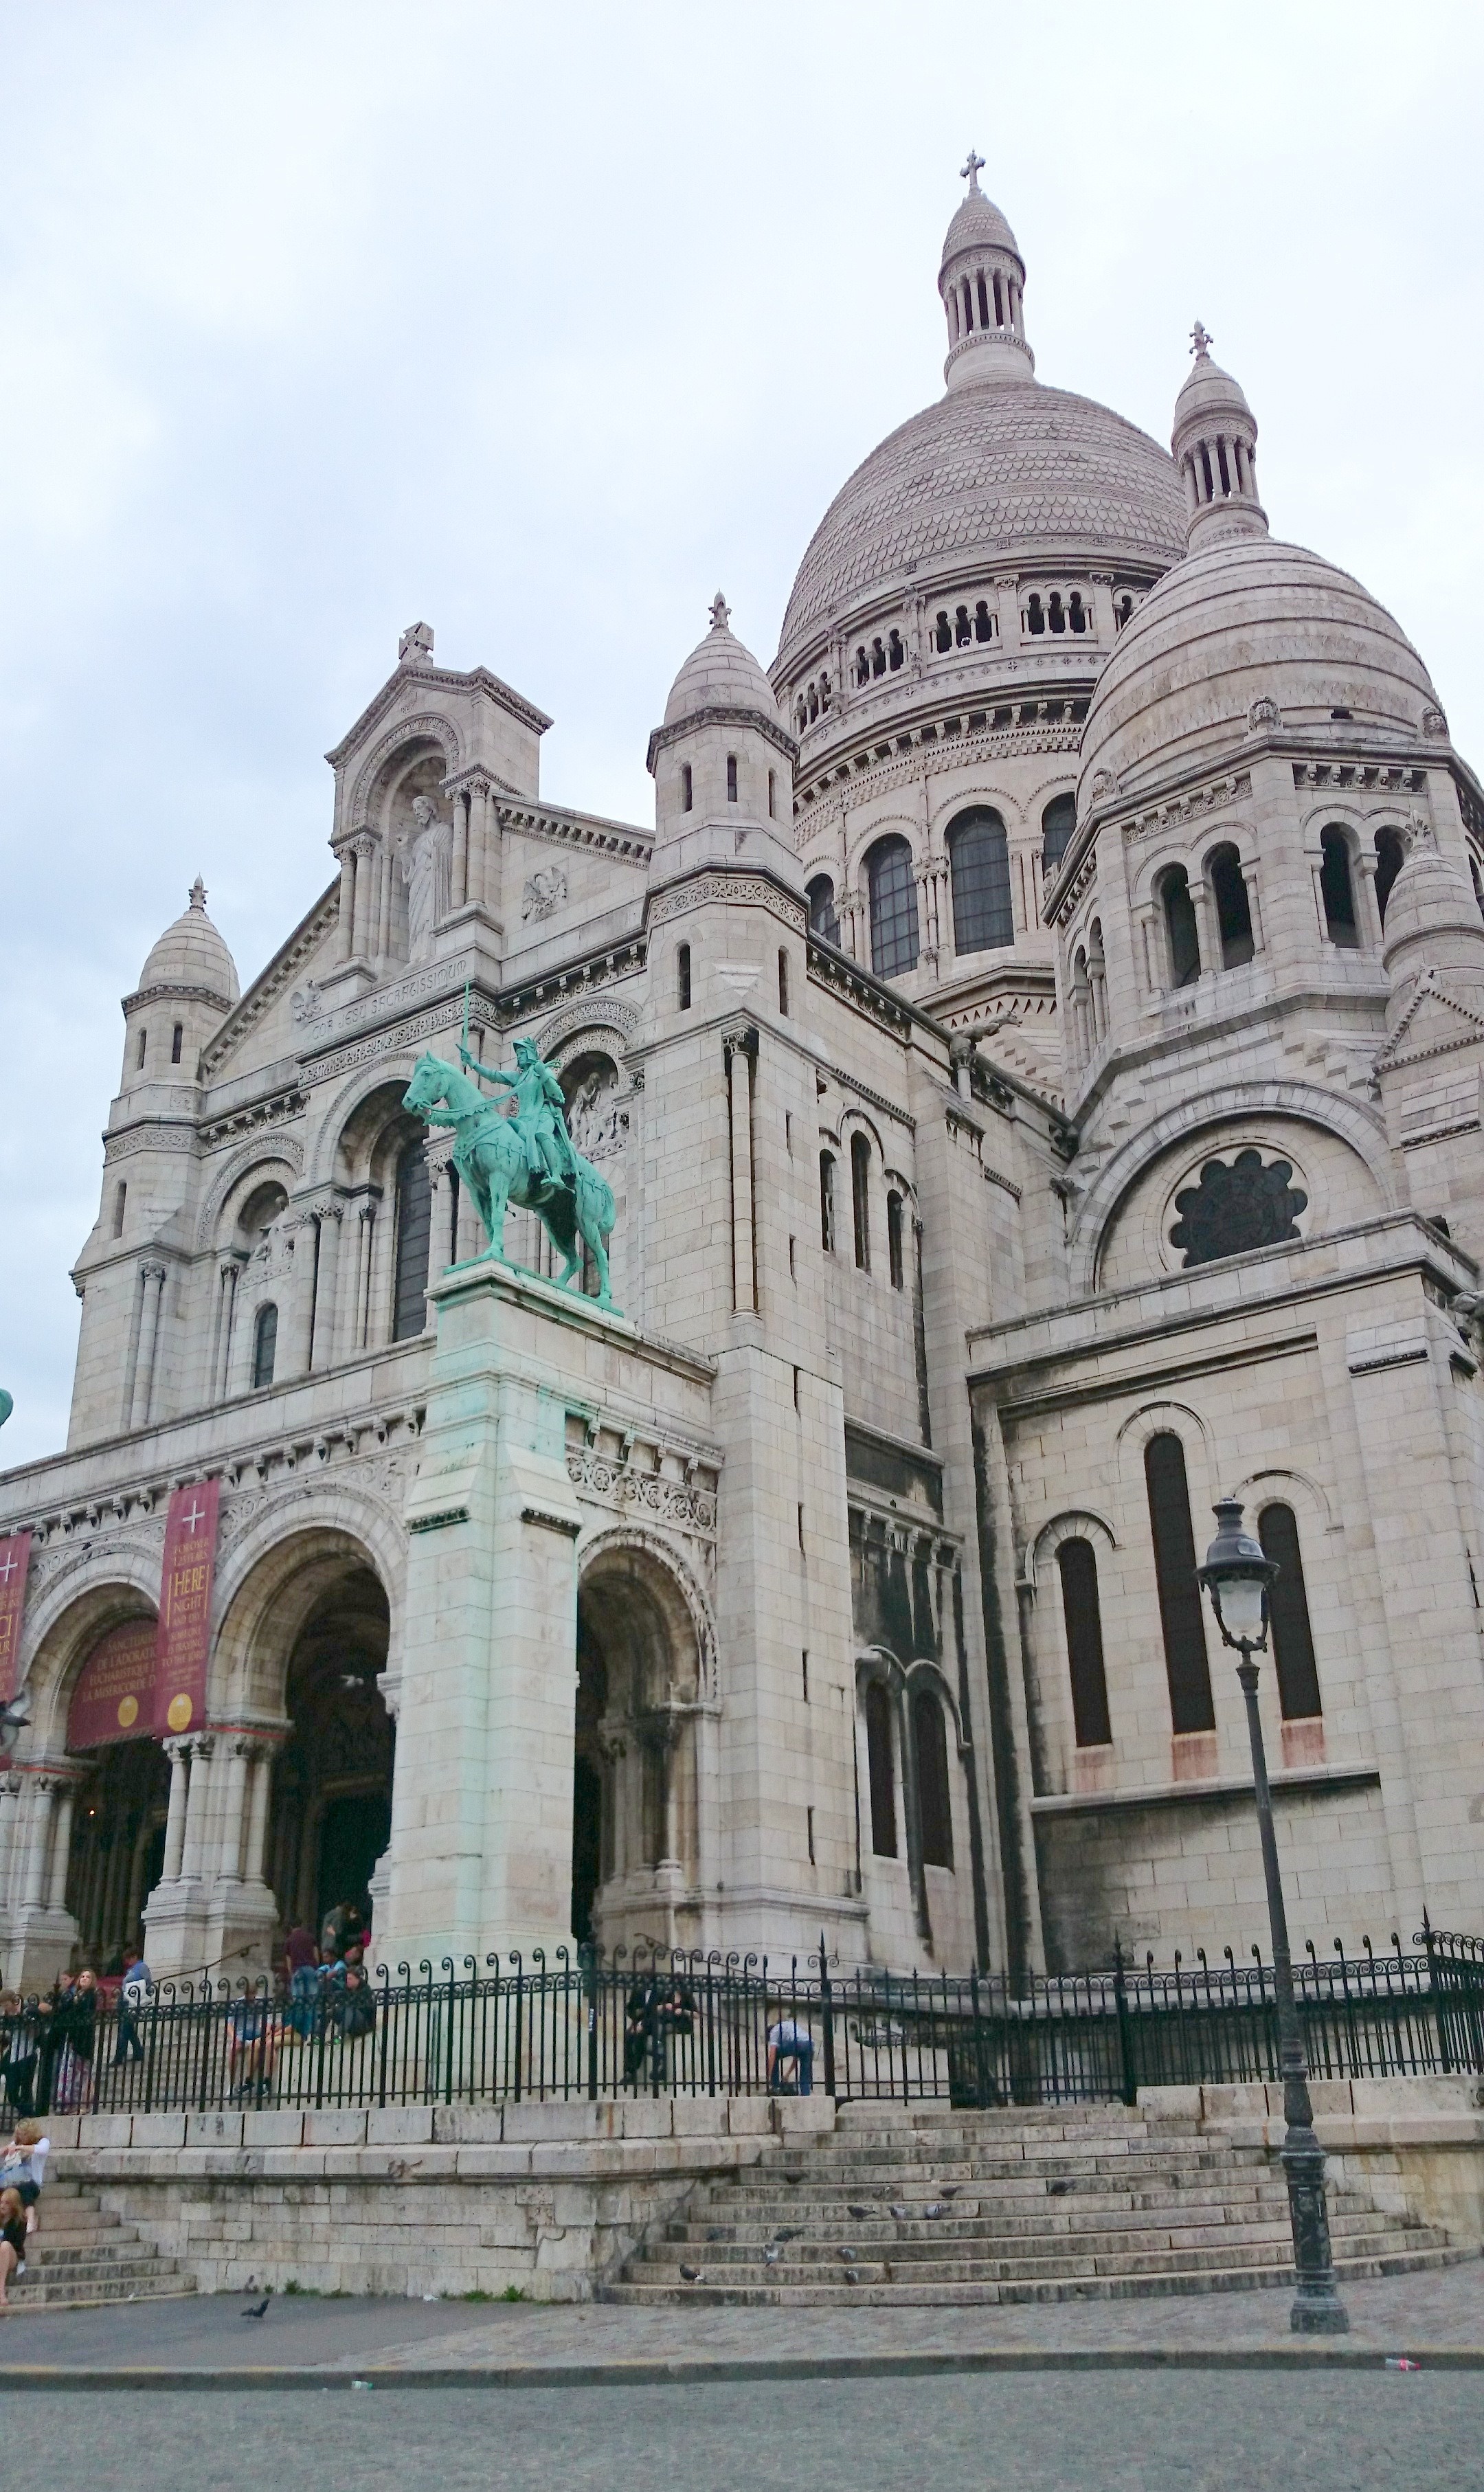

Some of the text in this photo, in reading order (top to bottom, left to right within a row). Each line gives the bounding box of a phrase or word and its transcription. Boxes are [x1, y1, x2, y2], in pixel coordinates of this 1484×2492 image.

[313, 1020, 333, 1040] COR
[174, 1565, 205, 1597] HERE
[174, 1593, 203, 1613] NIGHT
[0, 1615, 12, 1639] CI
[161, 1657, 172, 1668] TO
